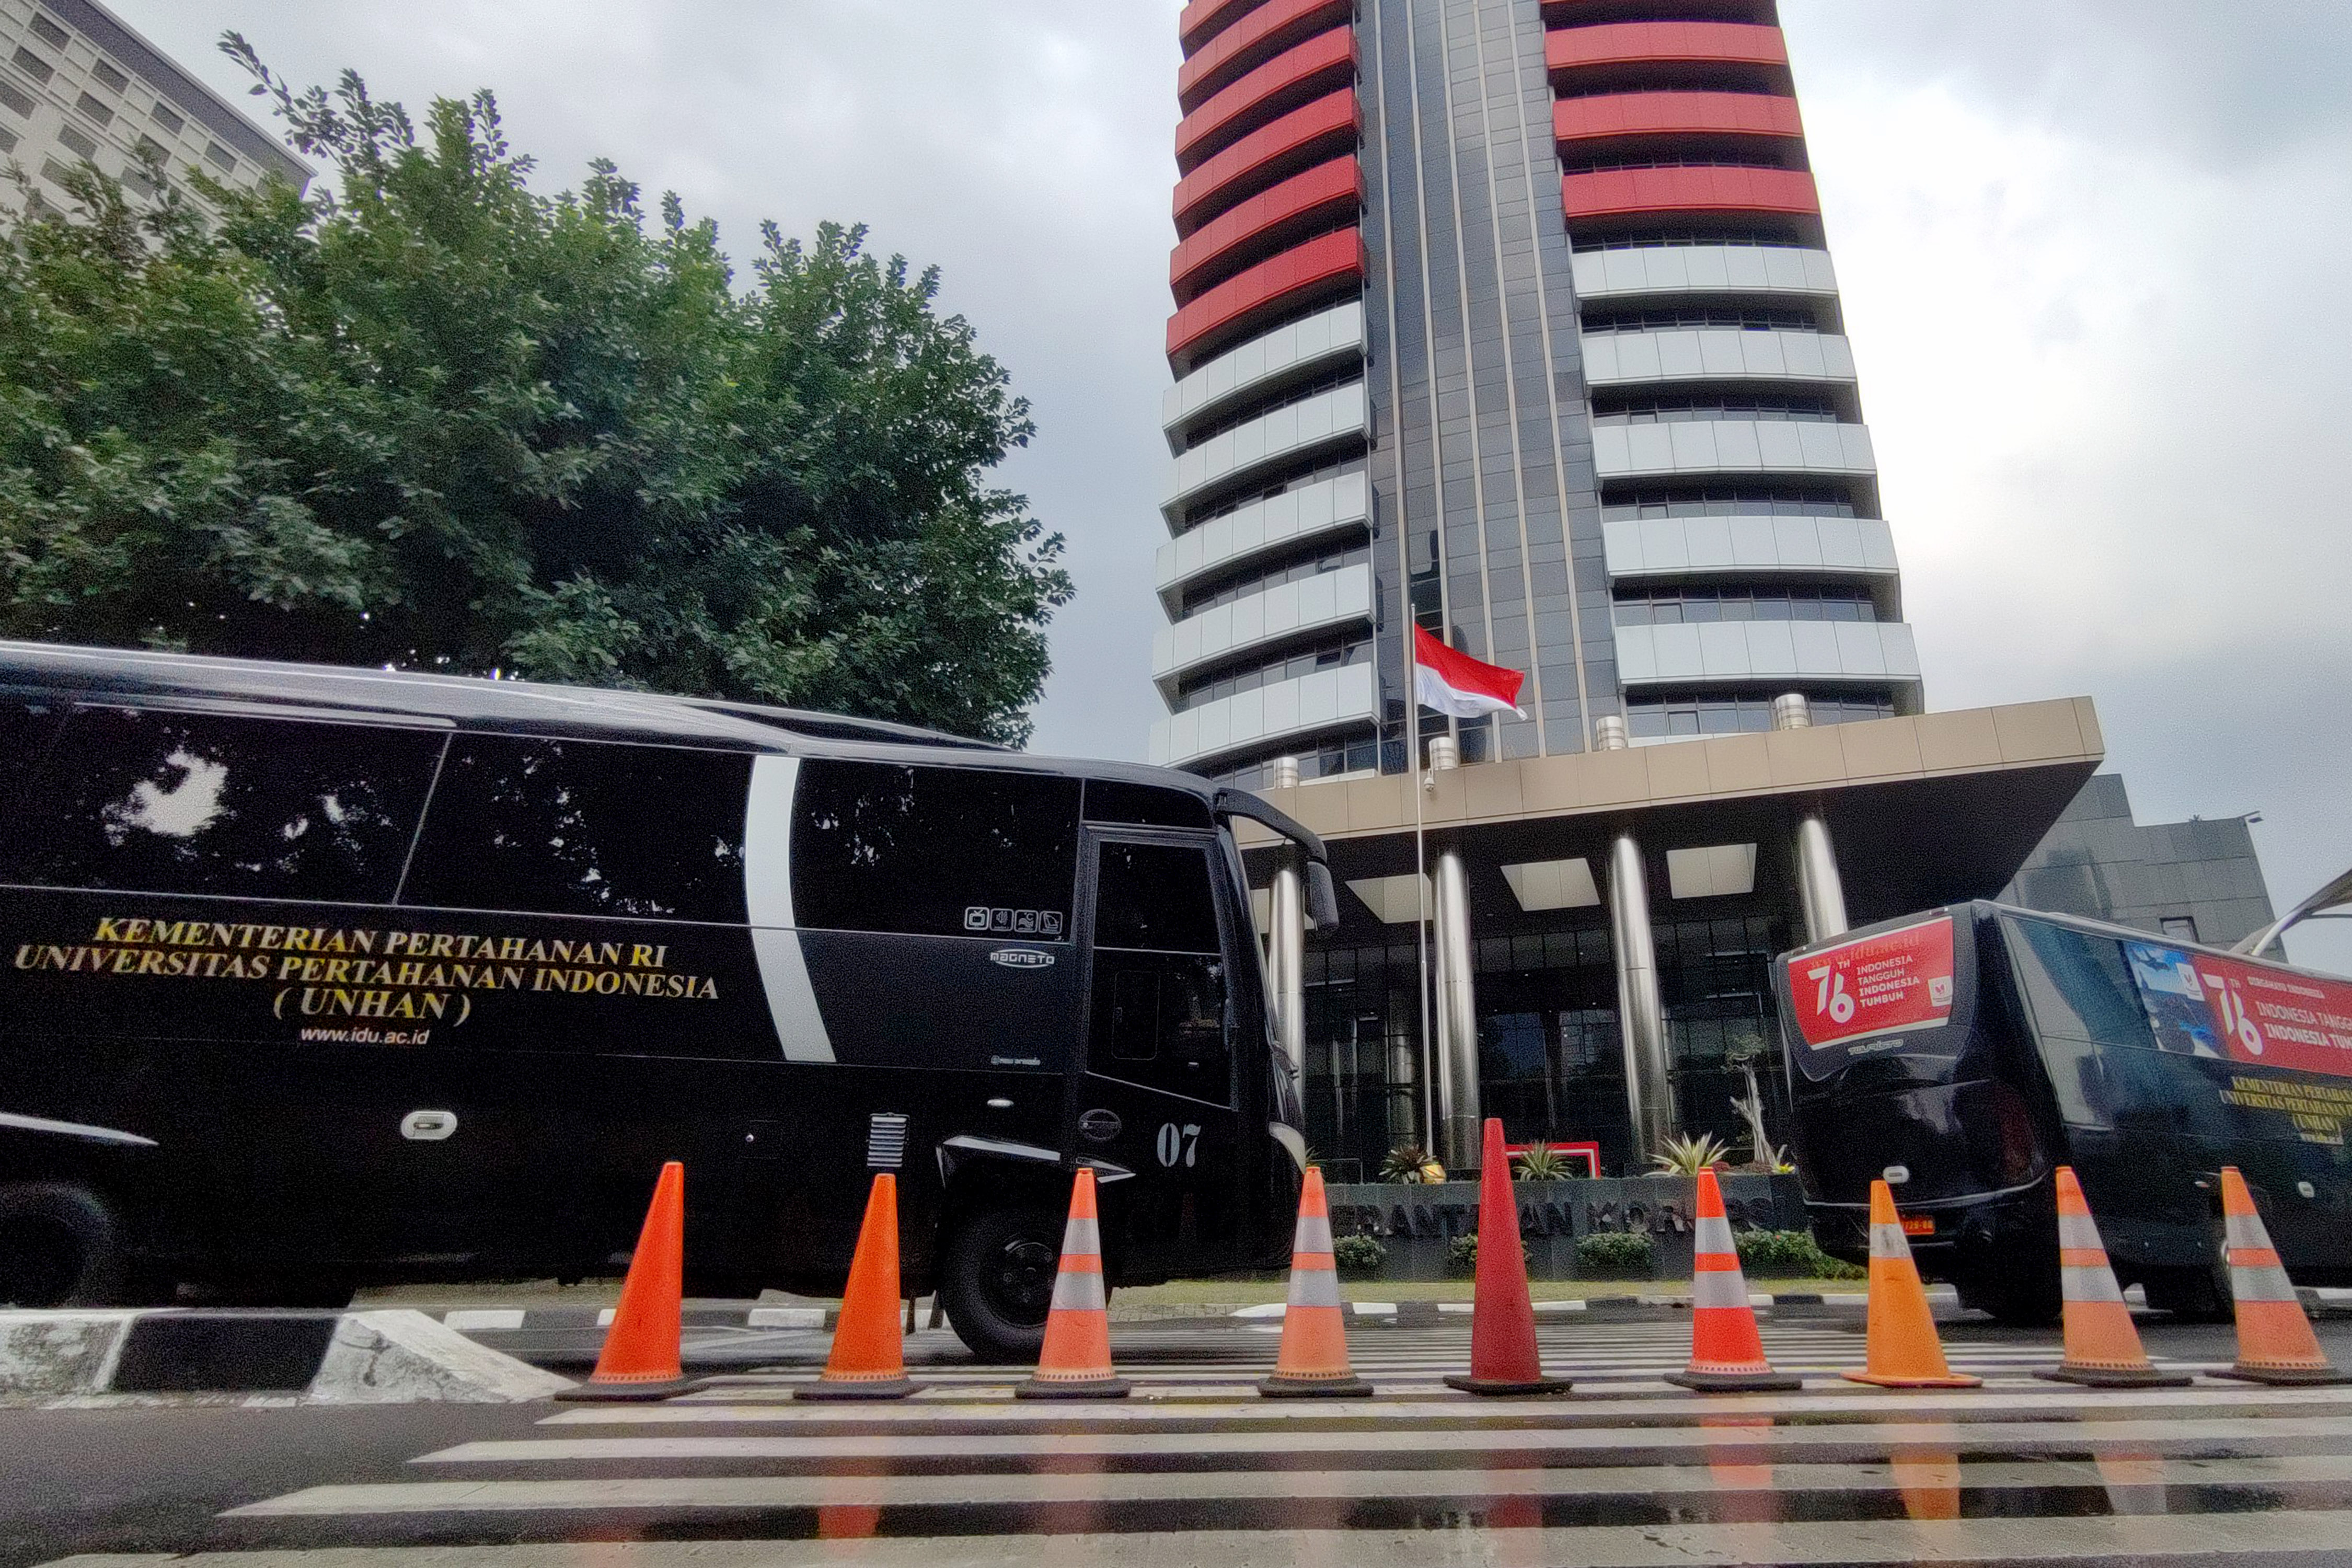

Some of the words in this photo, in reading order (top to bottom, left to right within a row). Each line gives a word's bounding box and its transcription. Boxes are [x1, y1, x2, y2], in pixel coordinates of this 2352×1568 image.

[94, 917, 379, 954] KEMENTERIAN
[383, 930, 622, 966] PERTAHANAN
[628, 943, 667, 967] RI
[14, 944, 270, 979] UNIVERSITAS
[277, 956, 525, 989] PERTAHANAN
[531, 968, 719, 999] INDONESIA
[1857, 955, 1913, 975] INDONESIA
[1858, 968, 1905, 985] TANGGUH
[1807, 965, 1854, 1023] 76
[1837, 959, 1850, 970] TH
[1859, 976, 1920, 997] INDONESIA
[1860, 991, 1904, 1008] TUMBUH
[2201, 973, 2263, 1055] 76
[2256, 1001, 2318, 1025] INDONESIA
[2316, 1012, 2352, 1032] TANGG
[301, 1027, 431, 1046] www.idu.ac.id
[2264, 1023, 2331, 1047] INDONESIA
[2328, 1033, 2352, 1050] TUM
[2219, 1090, 2285, 1110] UNIVERSITAS
[2232, 1076, 2303, 1098] KEMENTERIAN
[2303, 1085, 2352, 1103] PERTAHAN
[1157, 1122, 1202, 1168] 07
